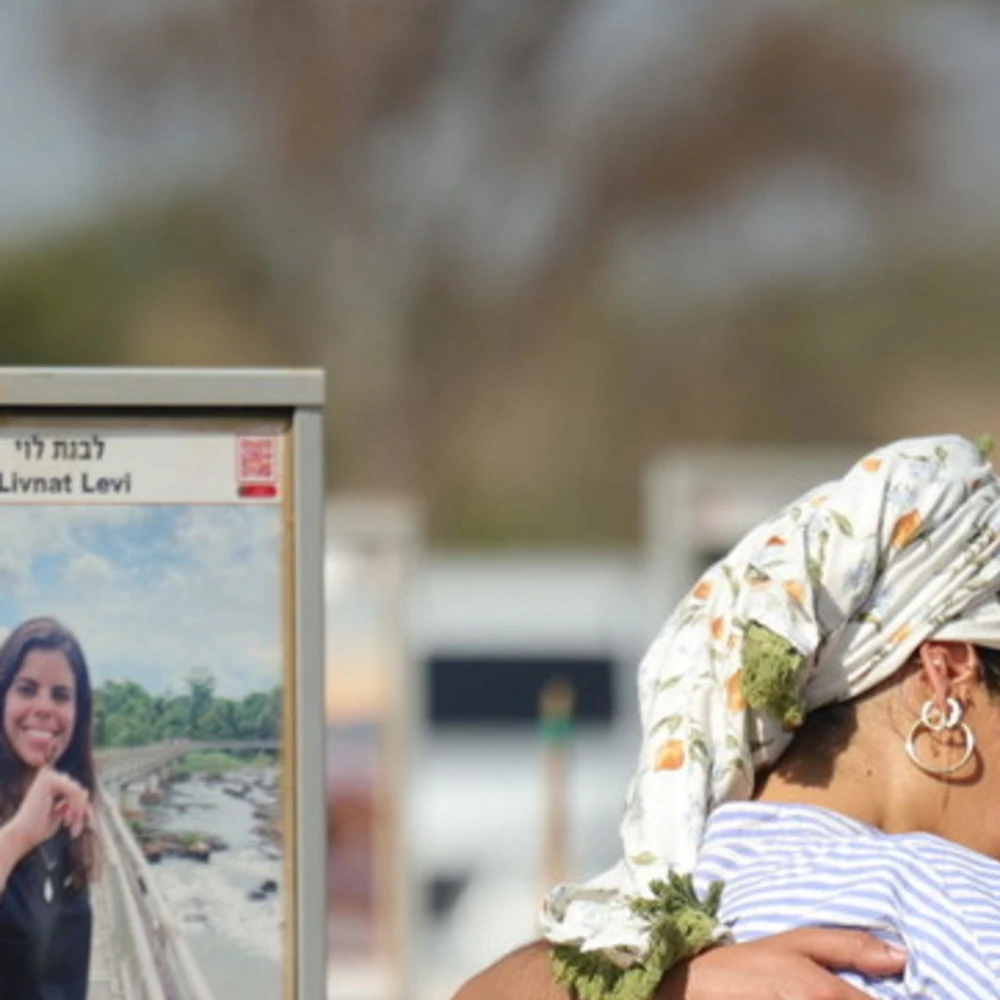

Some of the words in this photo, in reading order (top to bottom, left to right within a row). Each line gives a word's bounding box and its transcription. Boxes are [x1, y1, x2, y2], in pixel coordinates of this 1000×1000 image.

[15, 434, 44, 460] לוי
[52, 435, 106, 461] לבנת
[0, 473, 72, 494] Livnat
[81, 473, 132, 494] Levi
